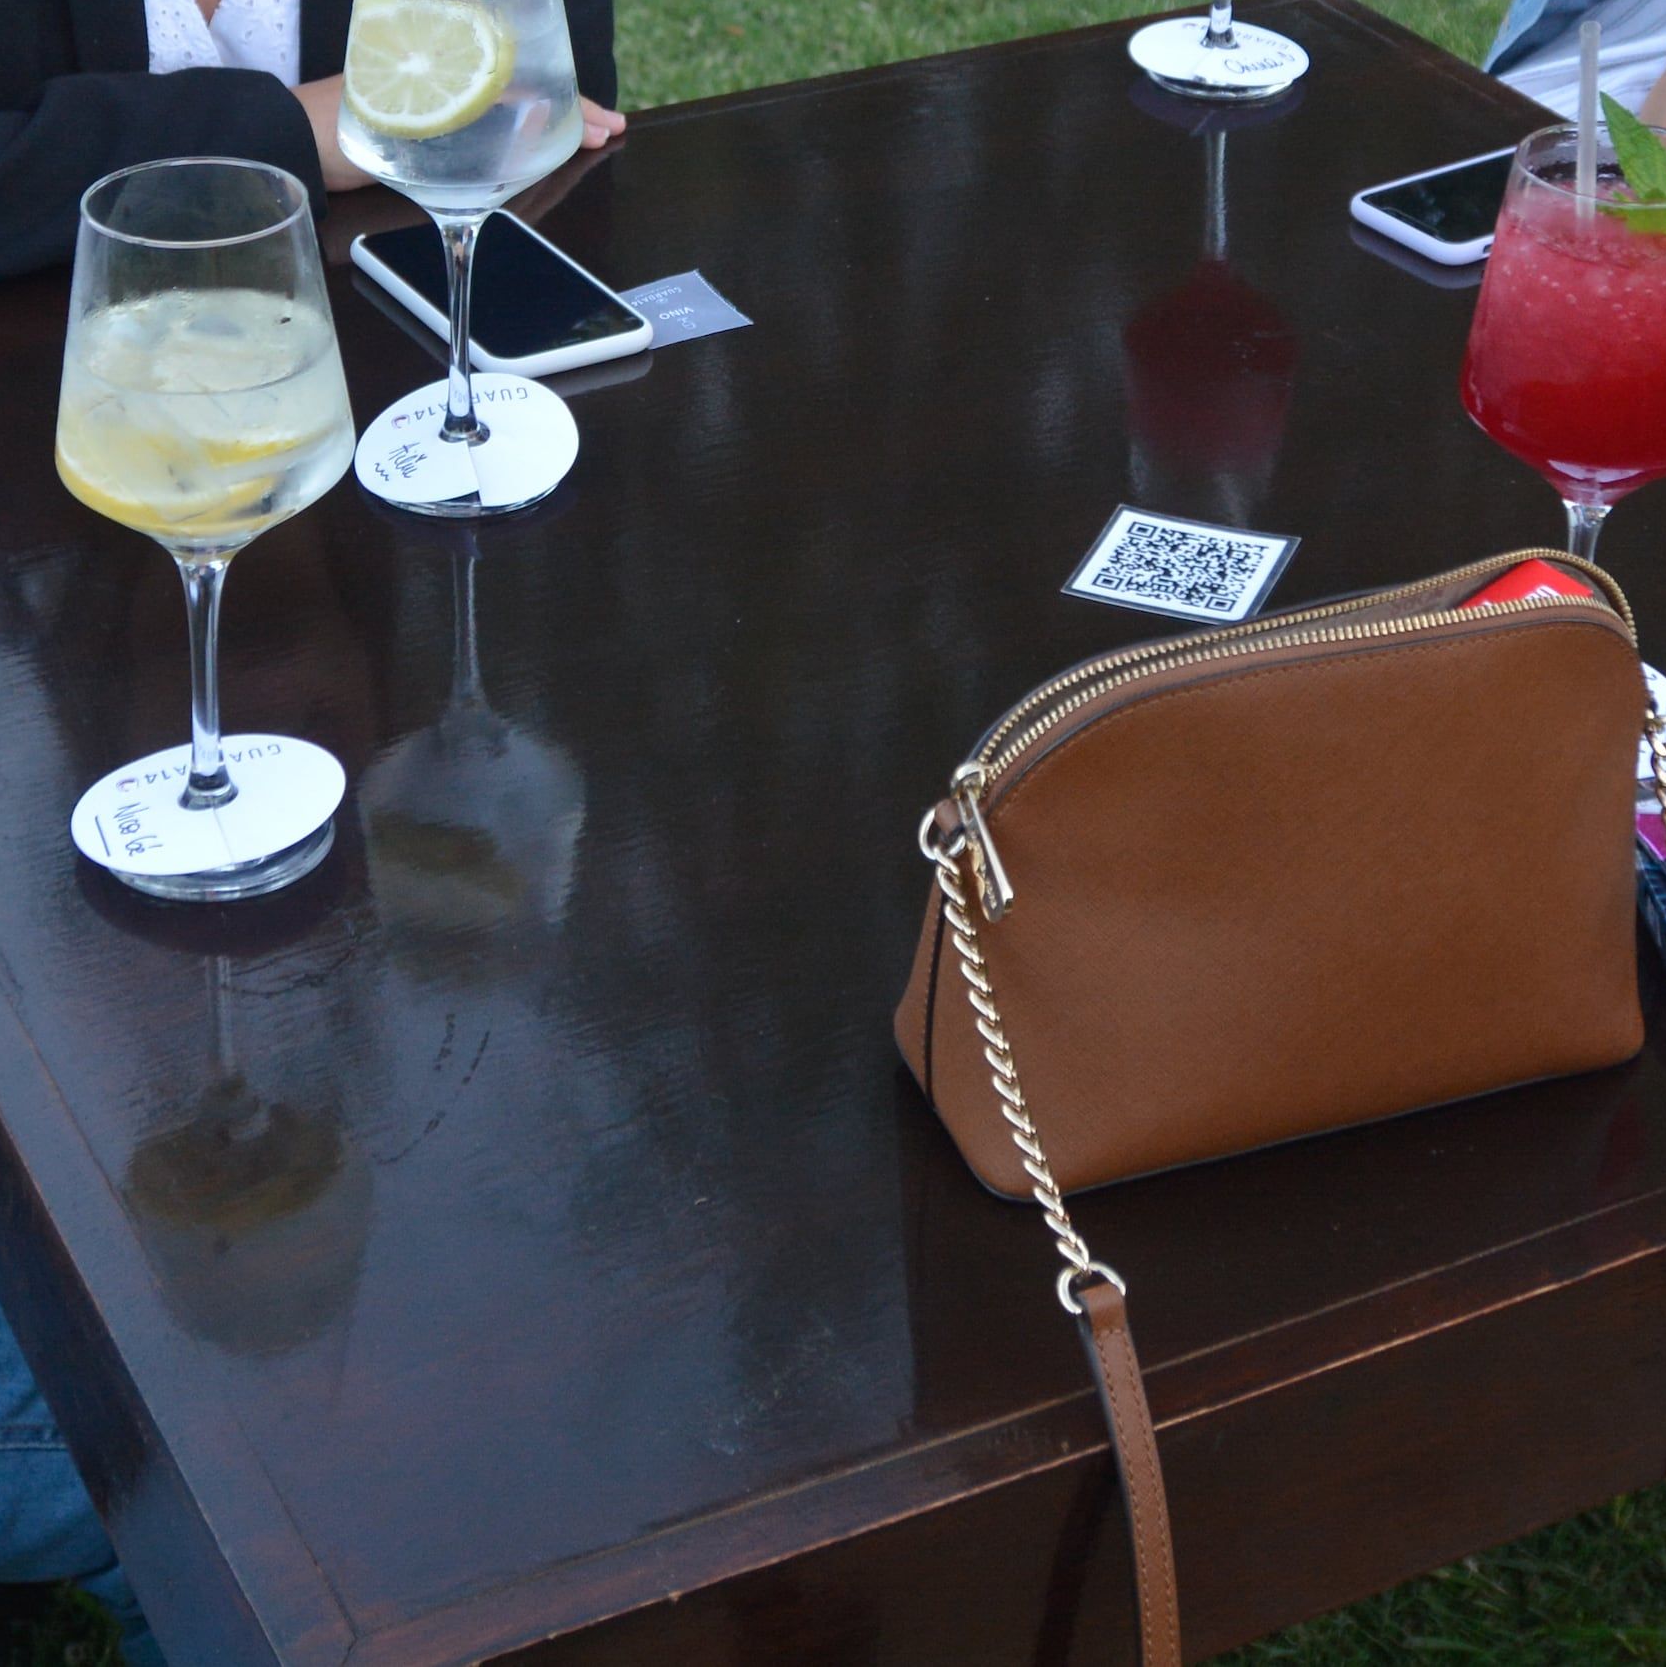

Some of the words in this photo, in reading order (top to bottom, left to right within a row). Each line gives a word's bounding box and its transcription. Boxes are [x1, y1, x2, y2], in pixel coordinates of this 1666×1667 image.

[631, 286, 682, 307] GUARDA14
[658, 306, 695, 320] VINO
[415, 387, 529, 421] GUARA14
[144, 743, 282, 784] GUAA14
